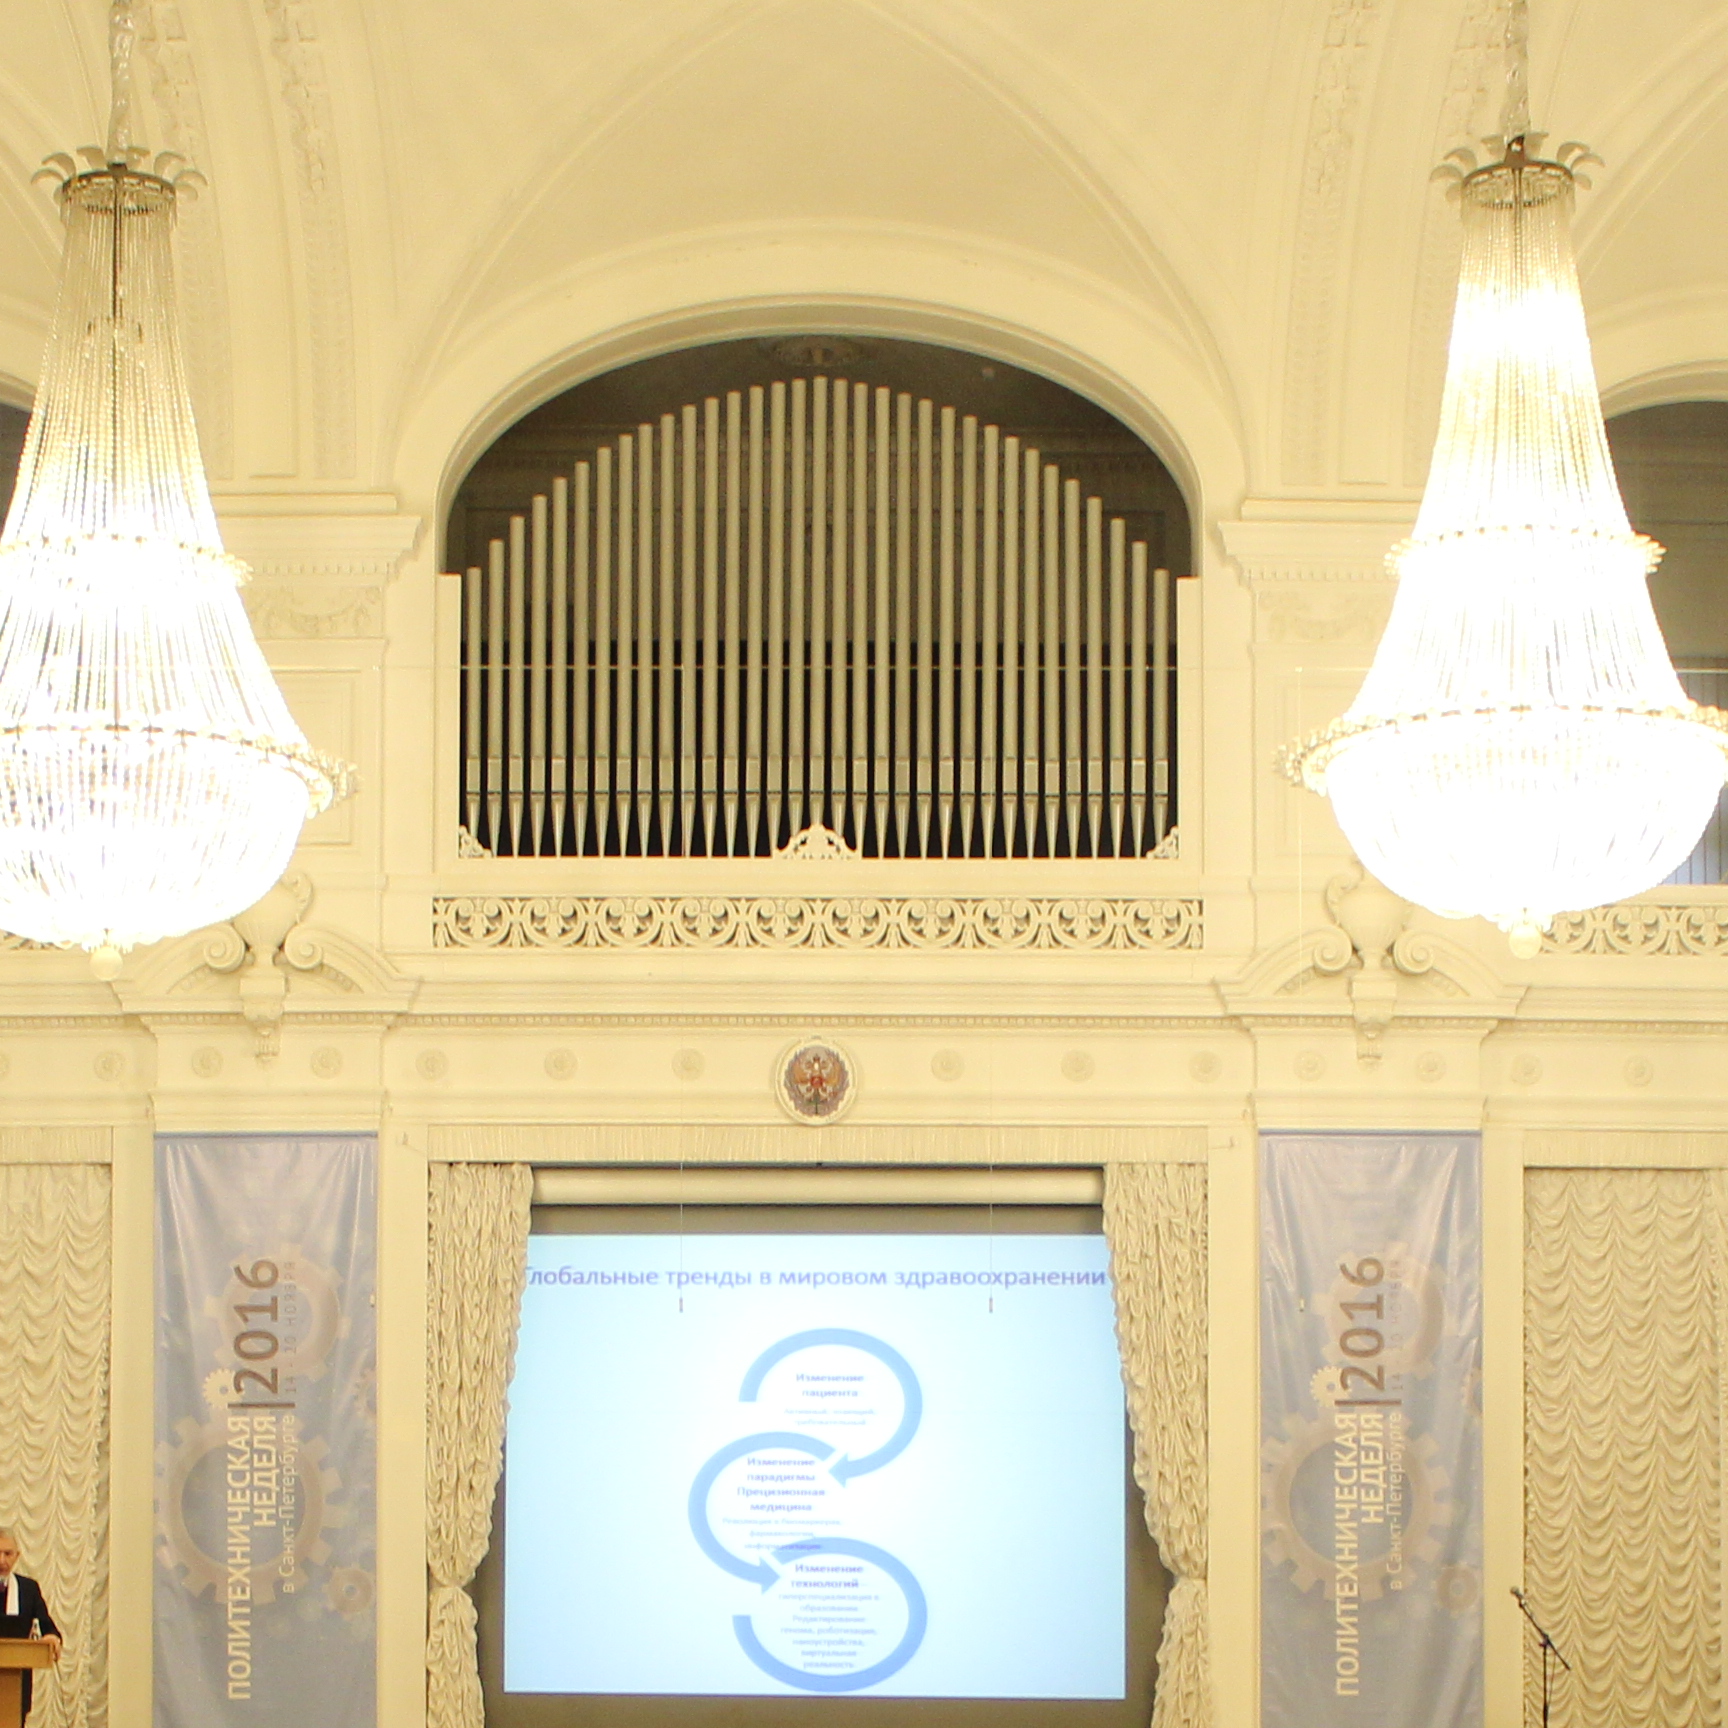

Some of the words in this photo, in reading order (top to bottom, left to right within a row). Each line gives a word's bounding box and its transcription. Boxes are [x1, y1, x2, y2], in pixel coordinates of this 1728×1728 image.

[233, 1260, 279, 1394] 2016
[666, 1270, 753, 1290] тренды
[760, 1270, 772, 1284] в
[779, 1270, 888, 1290] мировом
[894, 1270, 1108, 1290] здравоохранении
[1339, 1257, 1384, 1391] 2016
[254, 1415, 279, 1527] НЕДЕЛЯ
[279, 1414, 300, 1577] Санкт-Петербурге
[1361, 1412, 1386, 1523] НЕДЕЛЯ
[1387, 1411, 1407, 1575] Санкт-Петербурге
[227, 1415, 252, 1700] ПОЛИТЕХНИЧЕСКАЯ
[283, 1580, 295, 1593] в
[1334, 1412, 1360, 1696] ПОЛИТЕХНИЧЕСКАЯ
[1390, 1580, 1402, 1590] в
